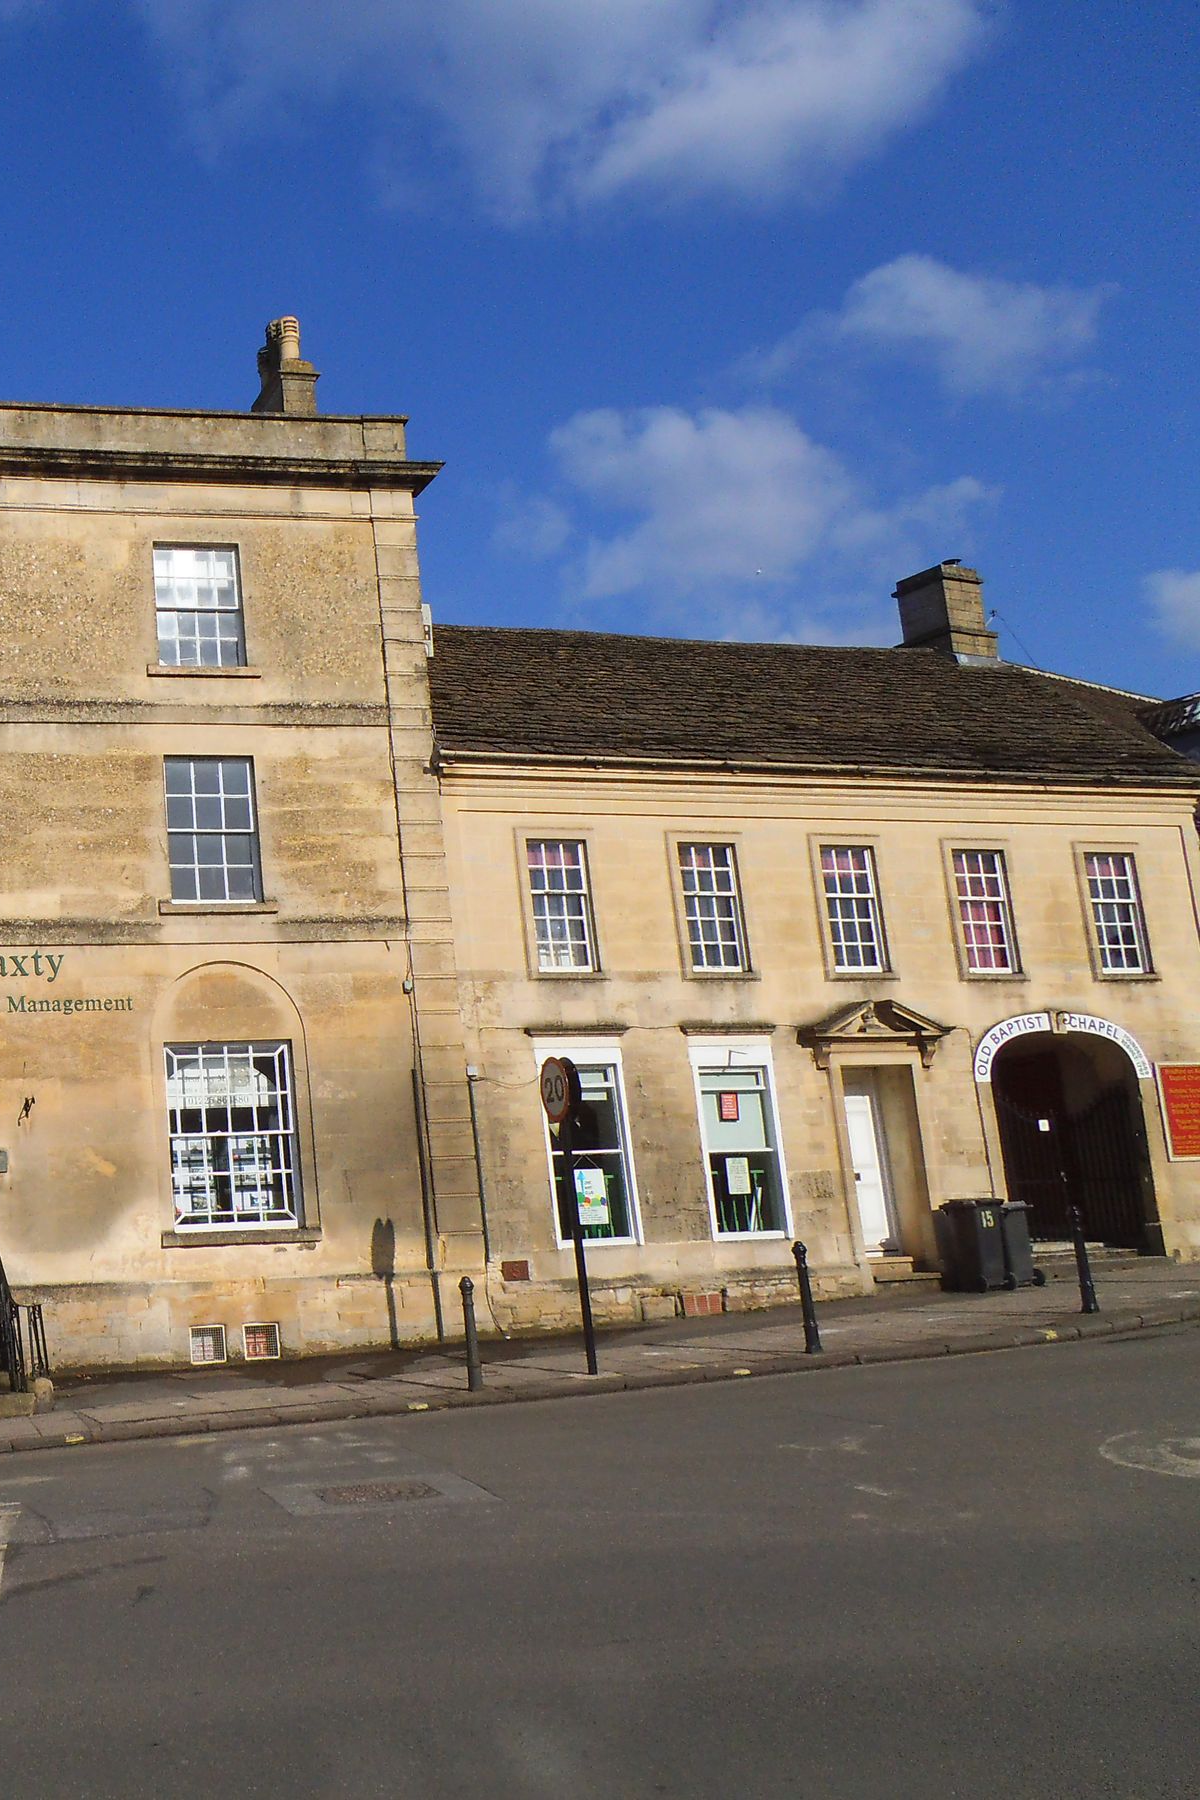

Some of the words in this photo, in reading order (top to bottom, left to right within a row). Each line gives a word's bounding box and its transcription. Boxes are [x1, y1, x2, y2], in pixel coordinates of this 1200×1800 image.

[6, 994, 133, 1015] Management
[977, 1045, 991, 1076] OLD
[989, 1016, 1042, 1045] BAPTIST
[1069, 1016, 1119, 1040] CHAPEL
[544, 1074, 563, 1103] 20
[981, 1210, 995, 1229] 15
